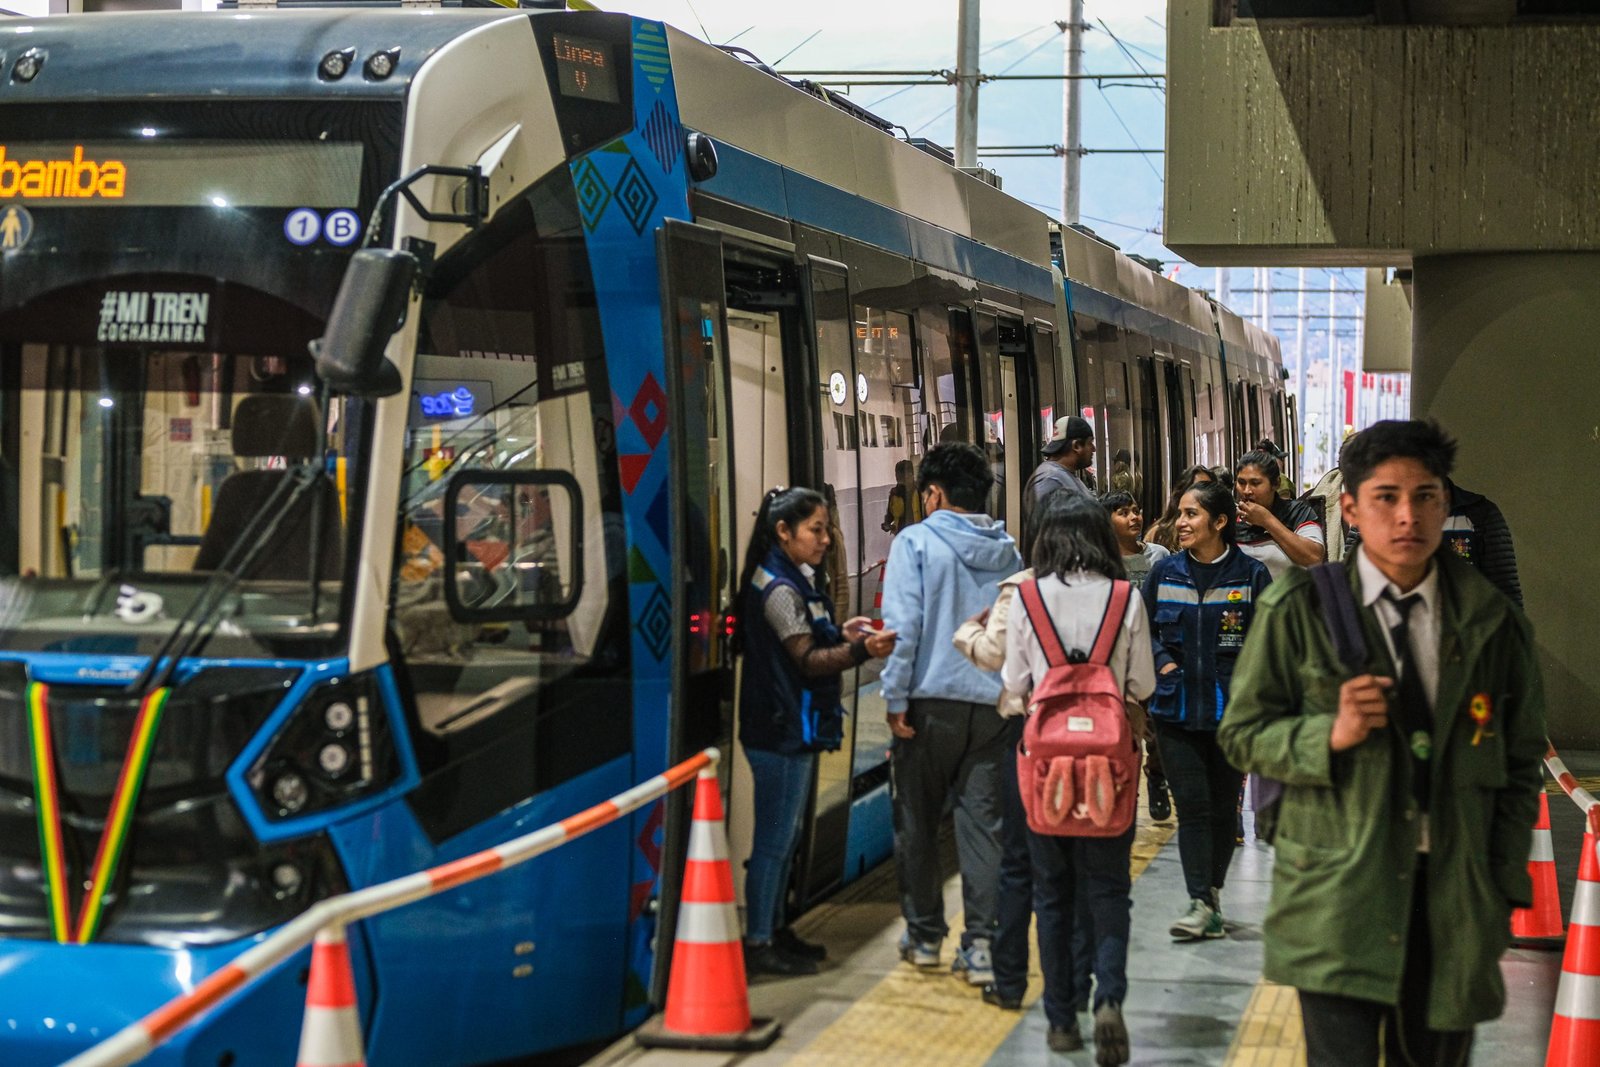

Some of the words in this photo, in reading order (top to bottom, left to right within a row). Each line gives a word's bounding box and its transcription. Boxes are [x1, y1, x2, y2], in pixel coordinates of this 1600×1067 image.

[553, 36, 605, 67] Linea
[0, 145, 126, 198] bamba
[334, 217, 352, 238] B
[99, 291, 149, 323] #MI
[152, 291, 209, 325] TREN
[97, 323, 206, 342] COCHABAMBA
